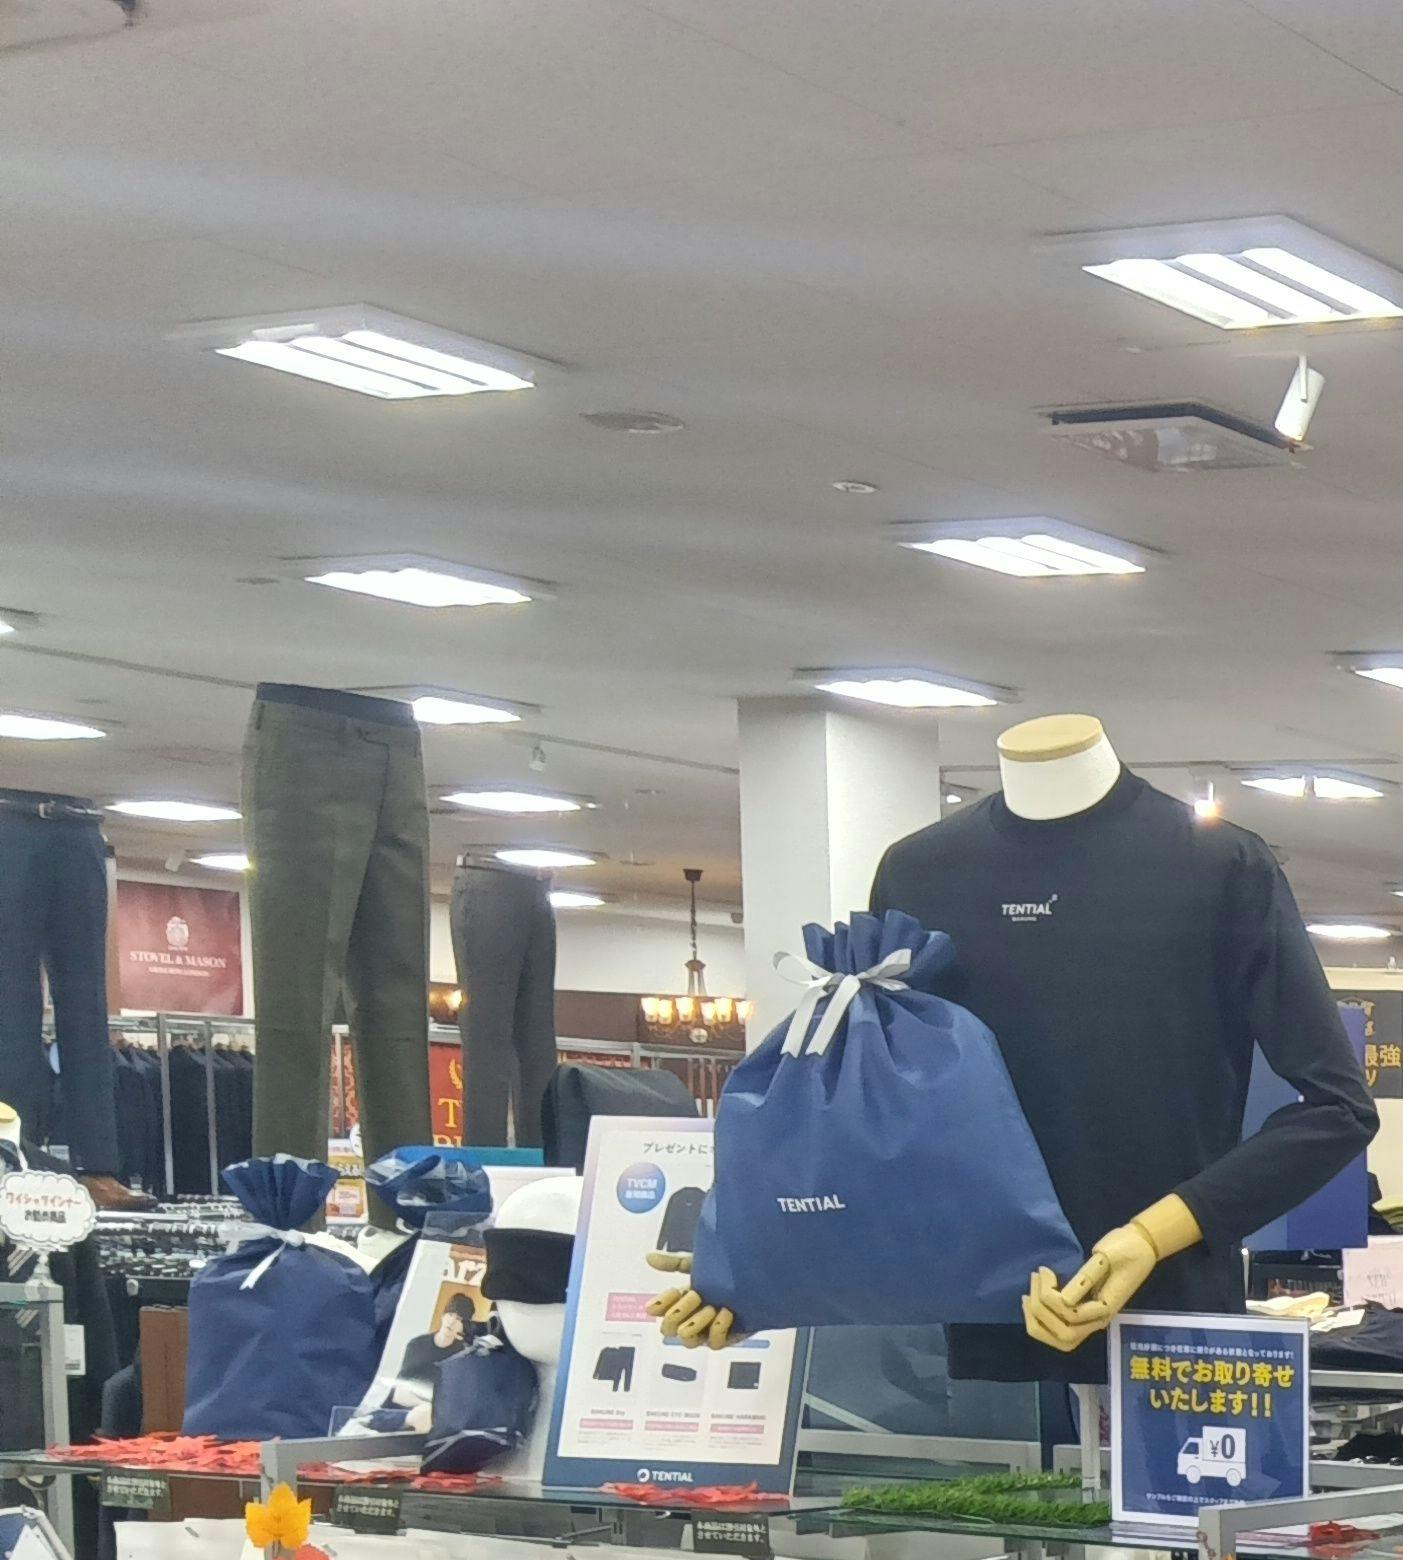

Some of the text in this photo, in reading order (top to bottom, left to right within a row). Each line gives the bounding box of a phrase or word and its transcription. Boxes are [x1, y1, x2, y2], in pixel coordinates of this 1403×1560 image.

[1001, 903, 1052, 915] TENTIAL
[643, 1142, 716, 1154] プレゼントに
[626, 1178, 658, 1189] TVCM
[777, 1194, 845, 1214] TENTIAL
[1129, 1355, 1296, 1388] 無料でお取り寄せ
[1149, 1387, 1273, 1418] いたします!!
[1209, 1433, 1236, 1460] ¥0
[652, 1471, 694, 1482] TENTIAL
